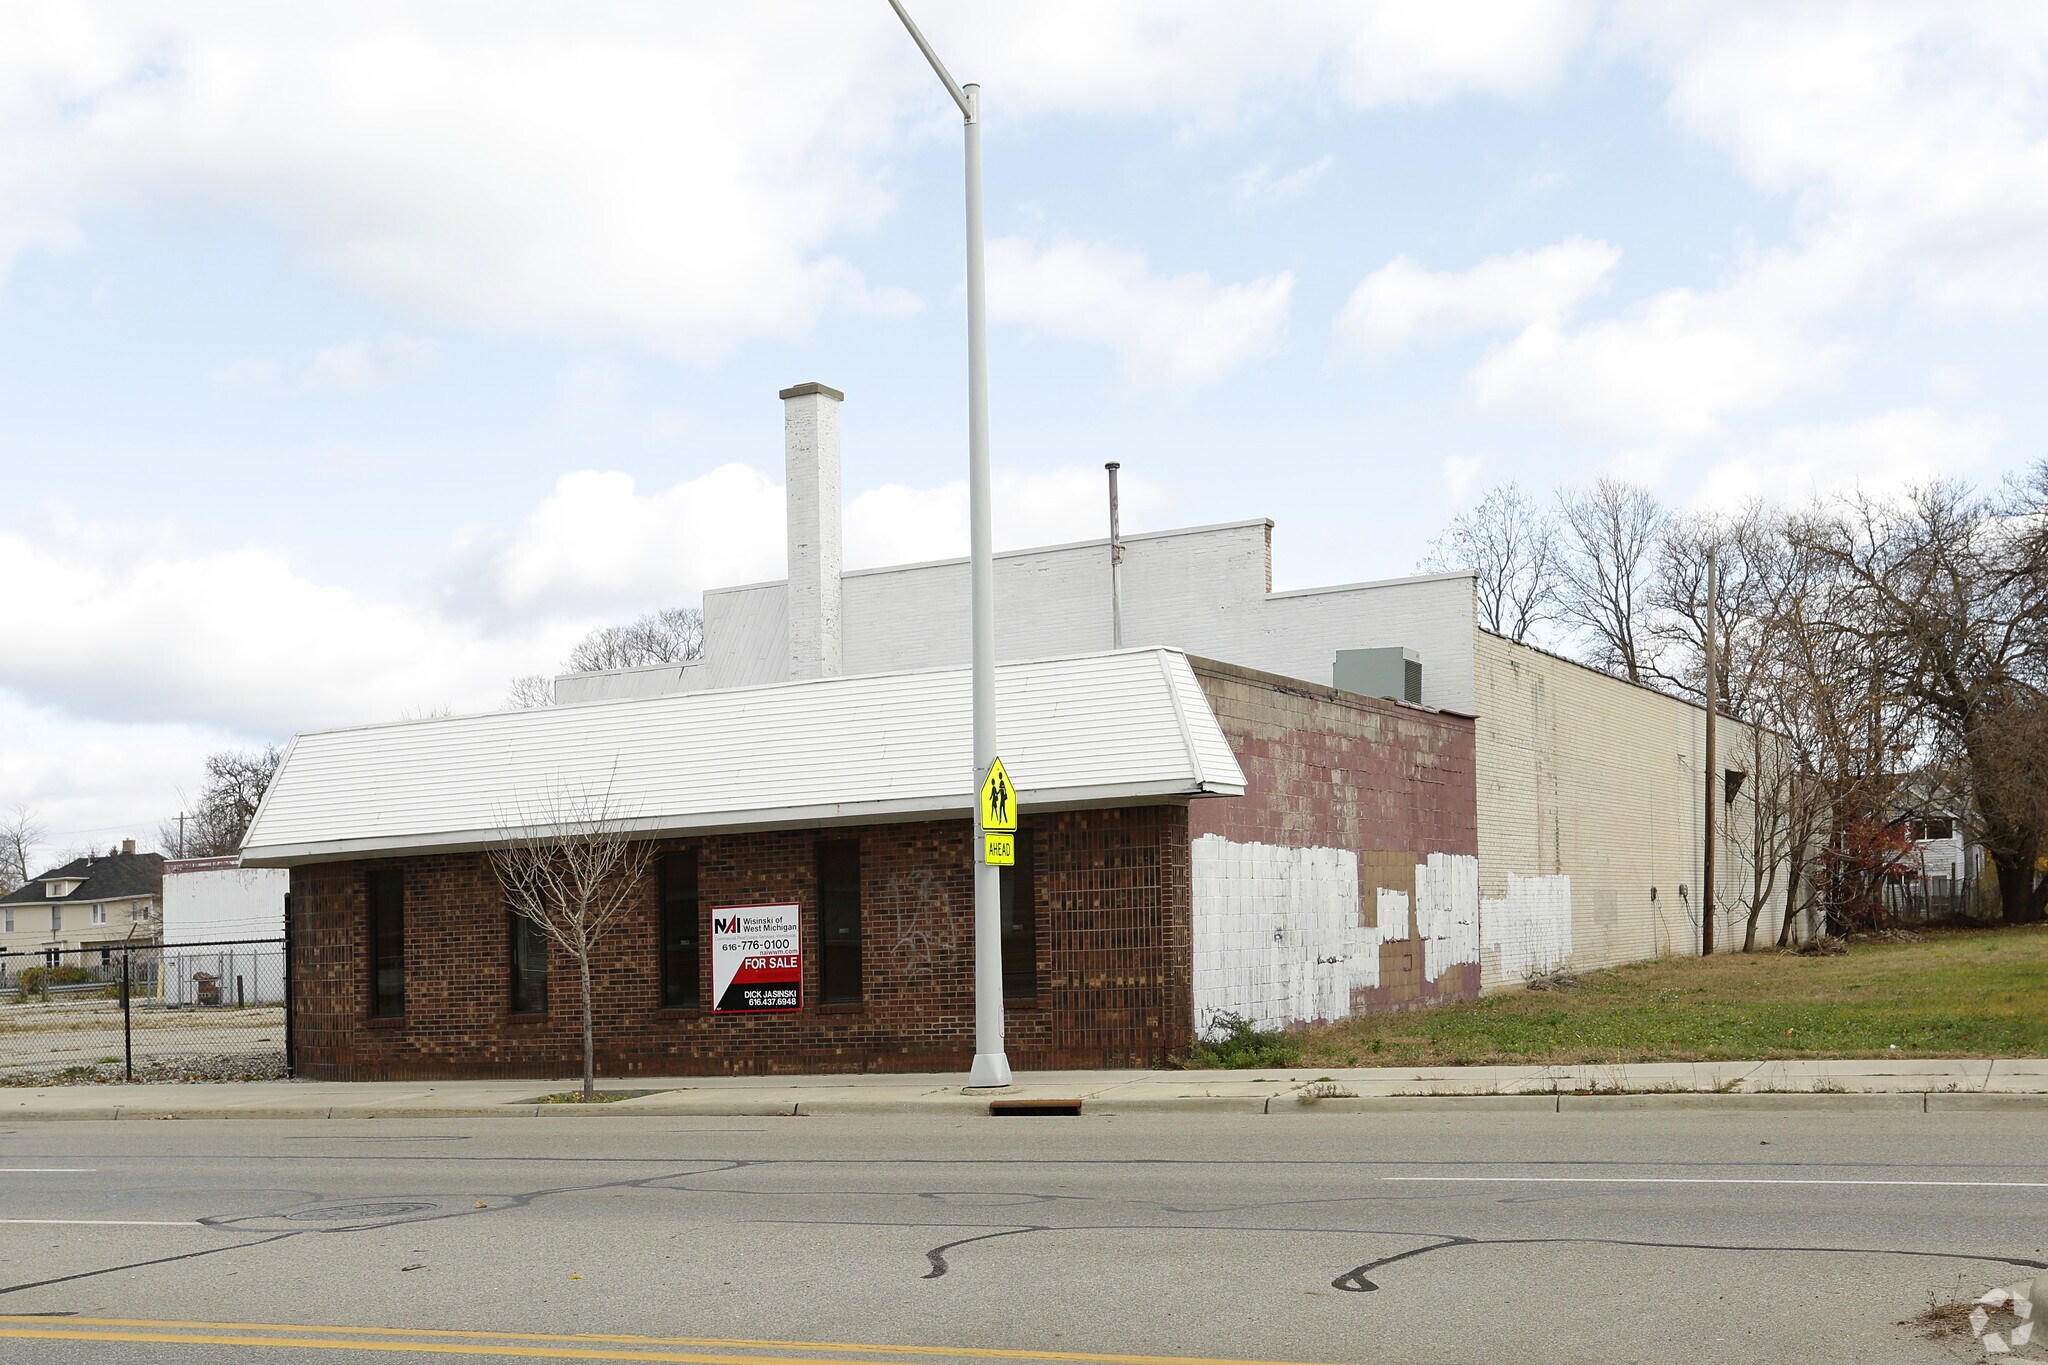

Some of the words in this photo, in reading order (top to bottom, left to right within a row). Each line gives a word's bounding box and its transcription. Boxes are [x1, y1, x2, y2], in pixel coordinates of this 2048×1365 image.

[989, 842, 1011, 857] AHEAD
[714, 914, 741, 934] NAI
[743, 917, 774, 925] Wisinski
[775, 916, 783, 924] of
[763, 924, 797, 932] Michigan
[722, 939, 790, 951] 616-776-0100
[745, 958, 766, 969] FOR
[769, 957, 798, 968] SALE
[744, 990, 762, 998] DICK
[763, 990, 796, 998] JASINSKI
[749, 997, 797, 1006] 616.437.6948
